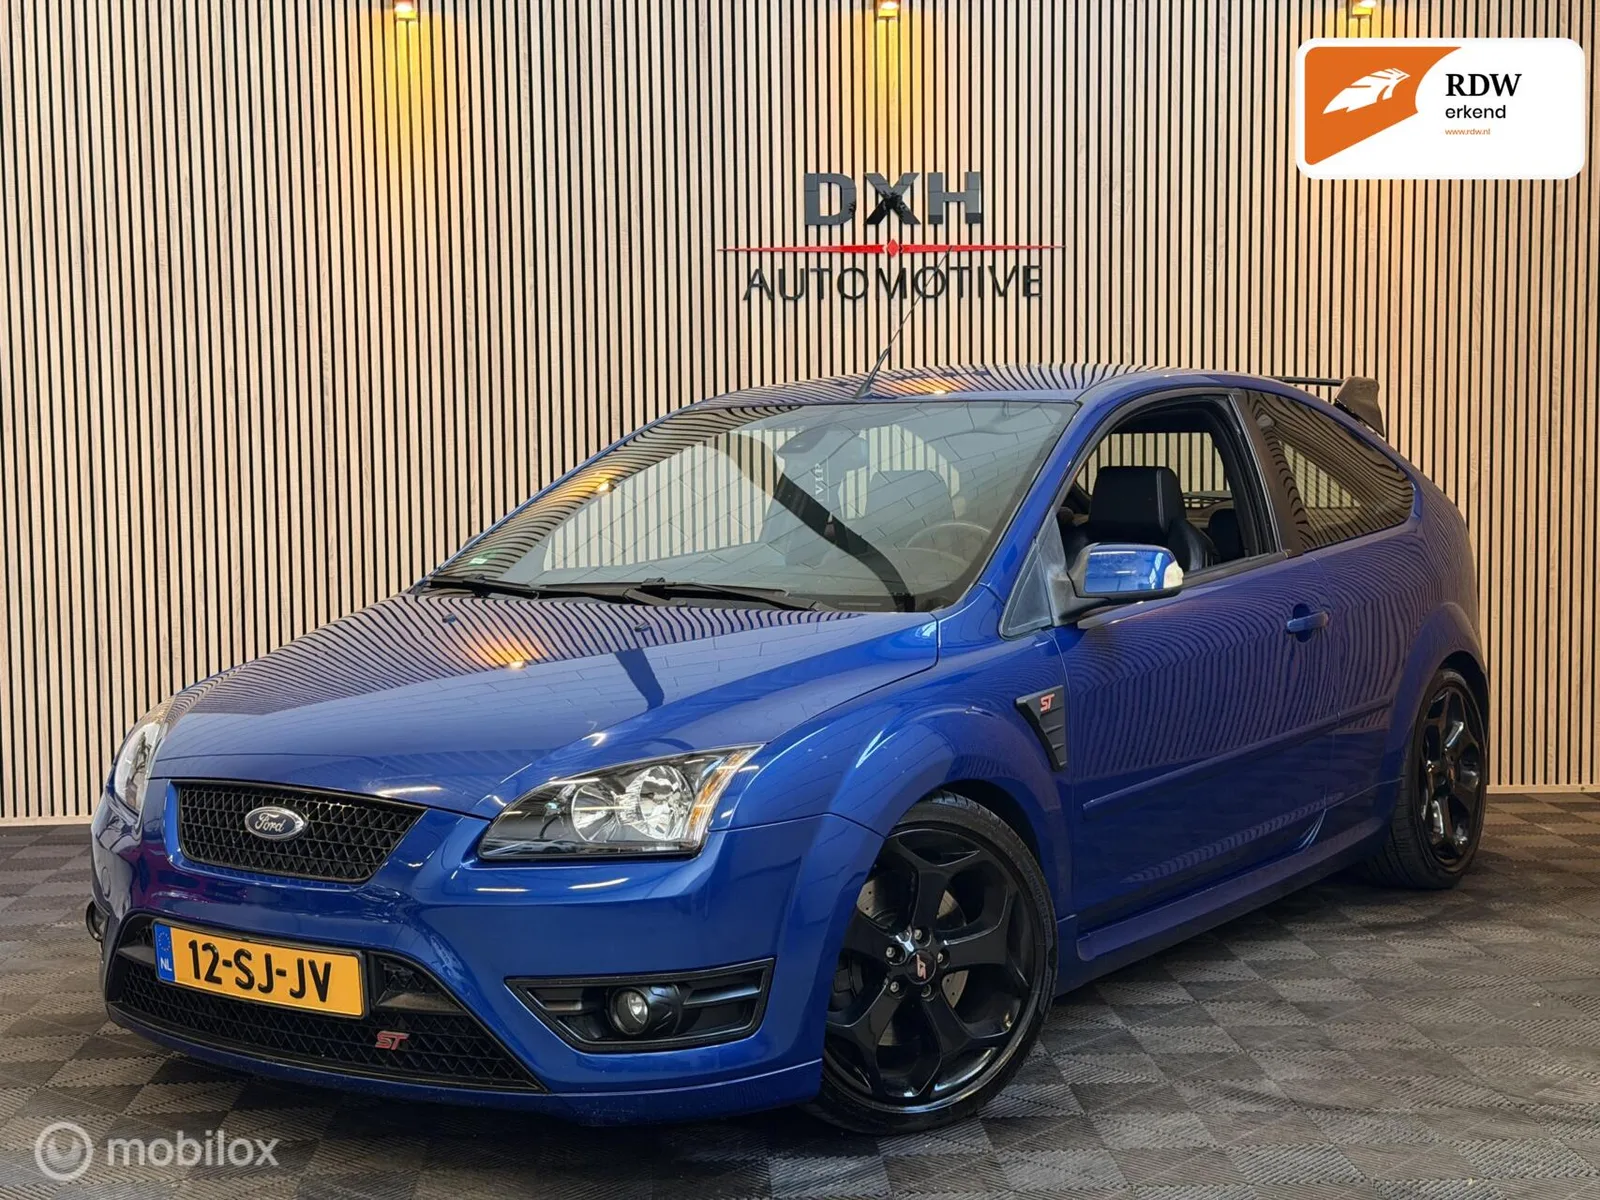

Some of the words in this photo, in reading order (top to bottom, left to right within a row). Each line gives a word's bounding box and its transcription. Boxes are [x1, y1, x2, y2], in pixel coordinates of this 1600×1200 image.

[804, 171, 982, 226] DXH
[743, 265, 1043, 301] AUTOMOTIVE
[1040, 693, 1056, 712] ST
[254, 812, 287, 832] Ford
[160, 957, 173, 972] NL
[188, 939, 332, 1003] 12-SJ-JV
[375, 1031, 411, 1051] ST
